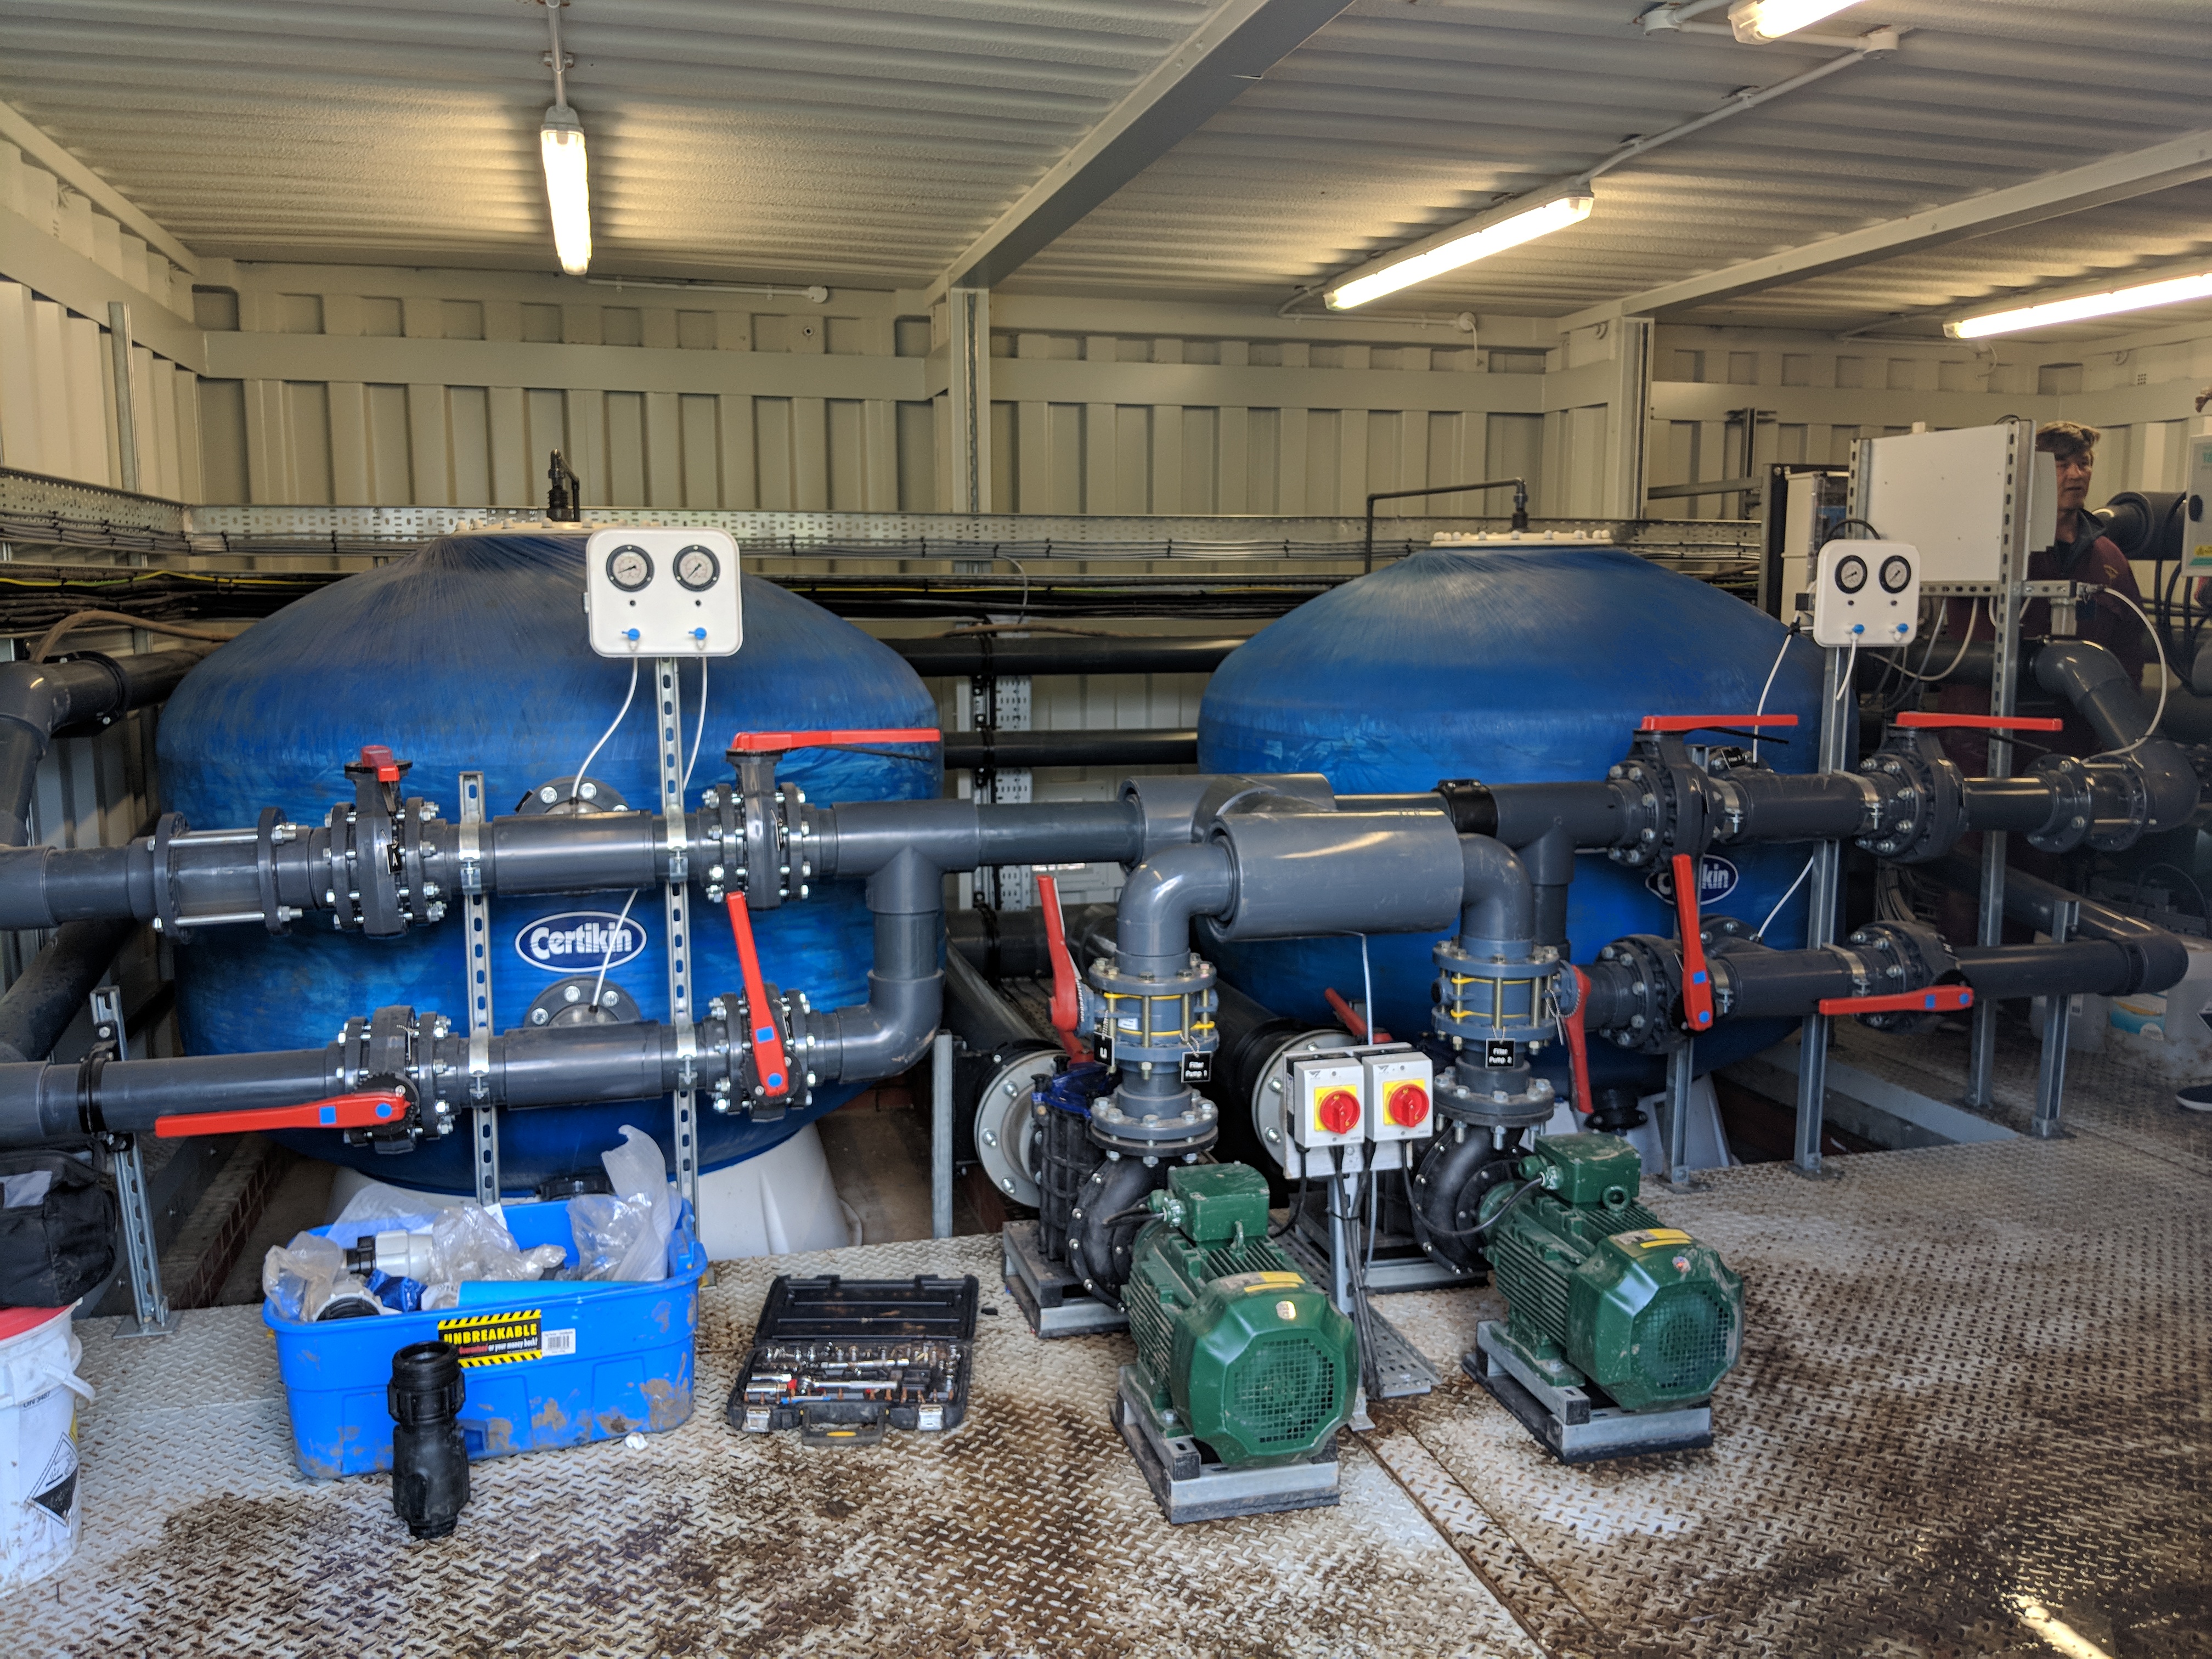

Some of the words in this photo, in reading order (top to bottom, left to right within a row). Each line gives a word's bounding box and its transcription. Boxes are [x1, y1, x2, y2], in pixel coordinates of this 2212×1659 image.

[392, 852, 398, 867] A
[1657, 863, 1729, 895] Ckin
[530, 922, 632, 960] Certikin
[1489, 1056, 1506, 1064] Pump
[443, 1323, 537, 1345] UNBREAKABLE
[23, 1399, 35, 1408] UN
